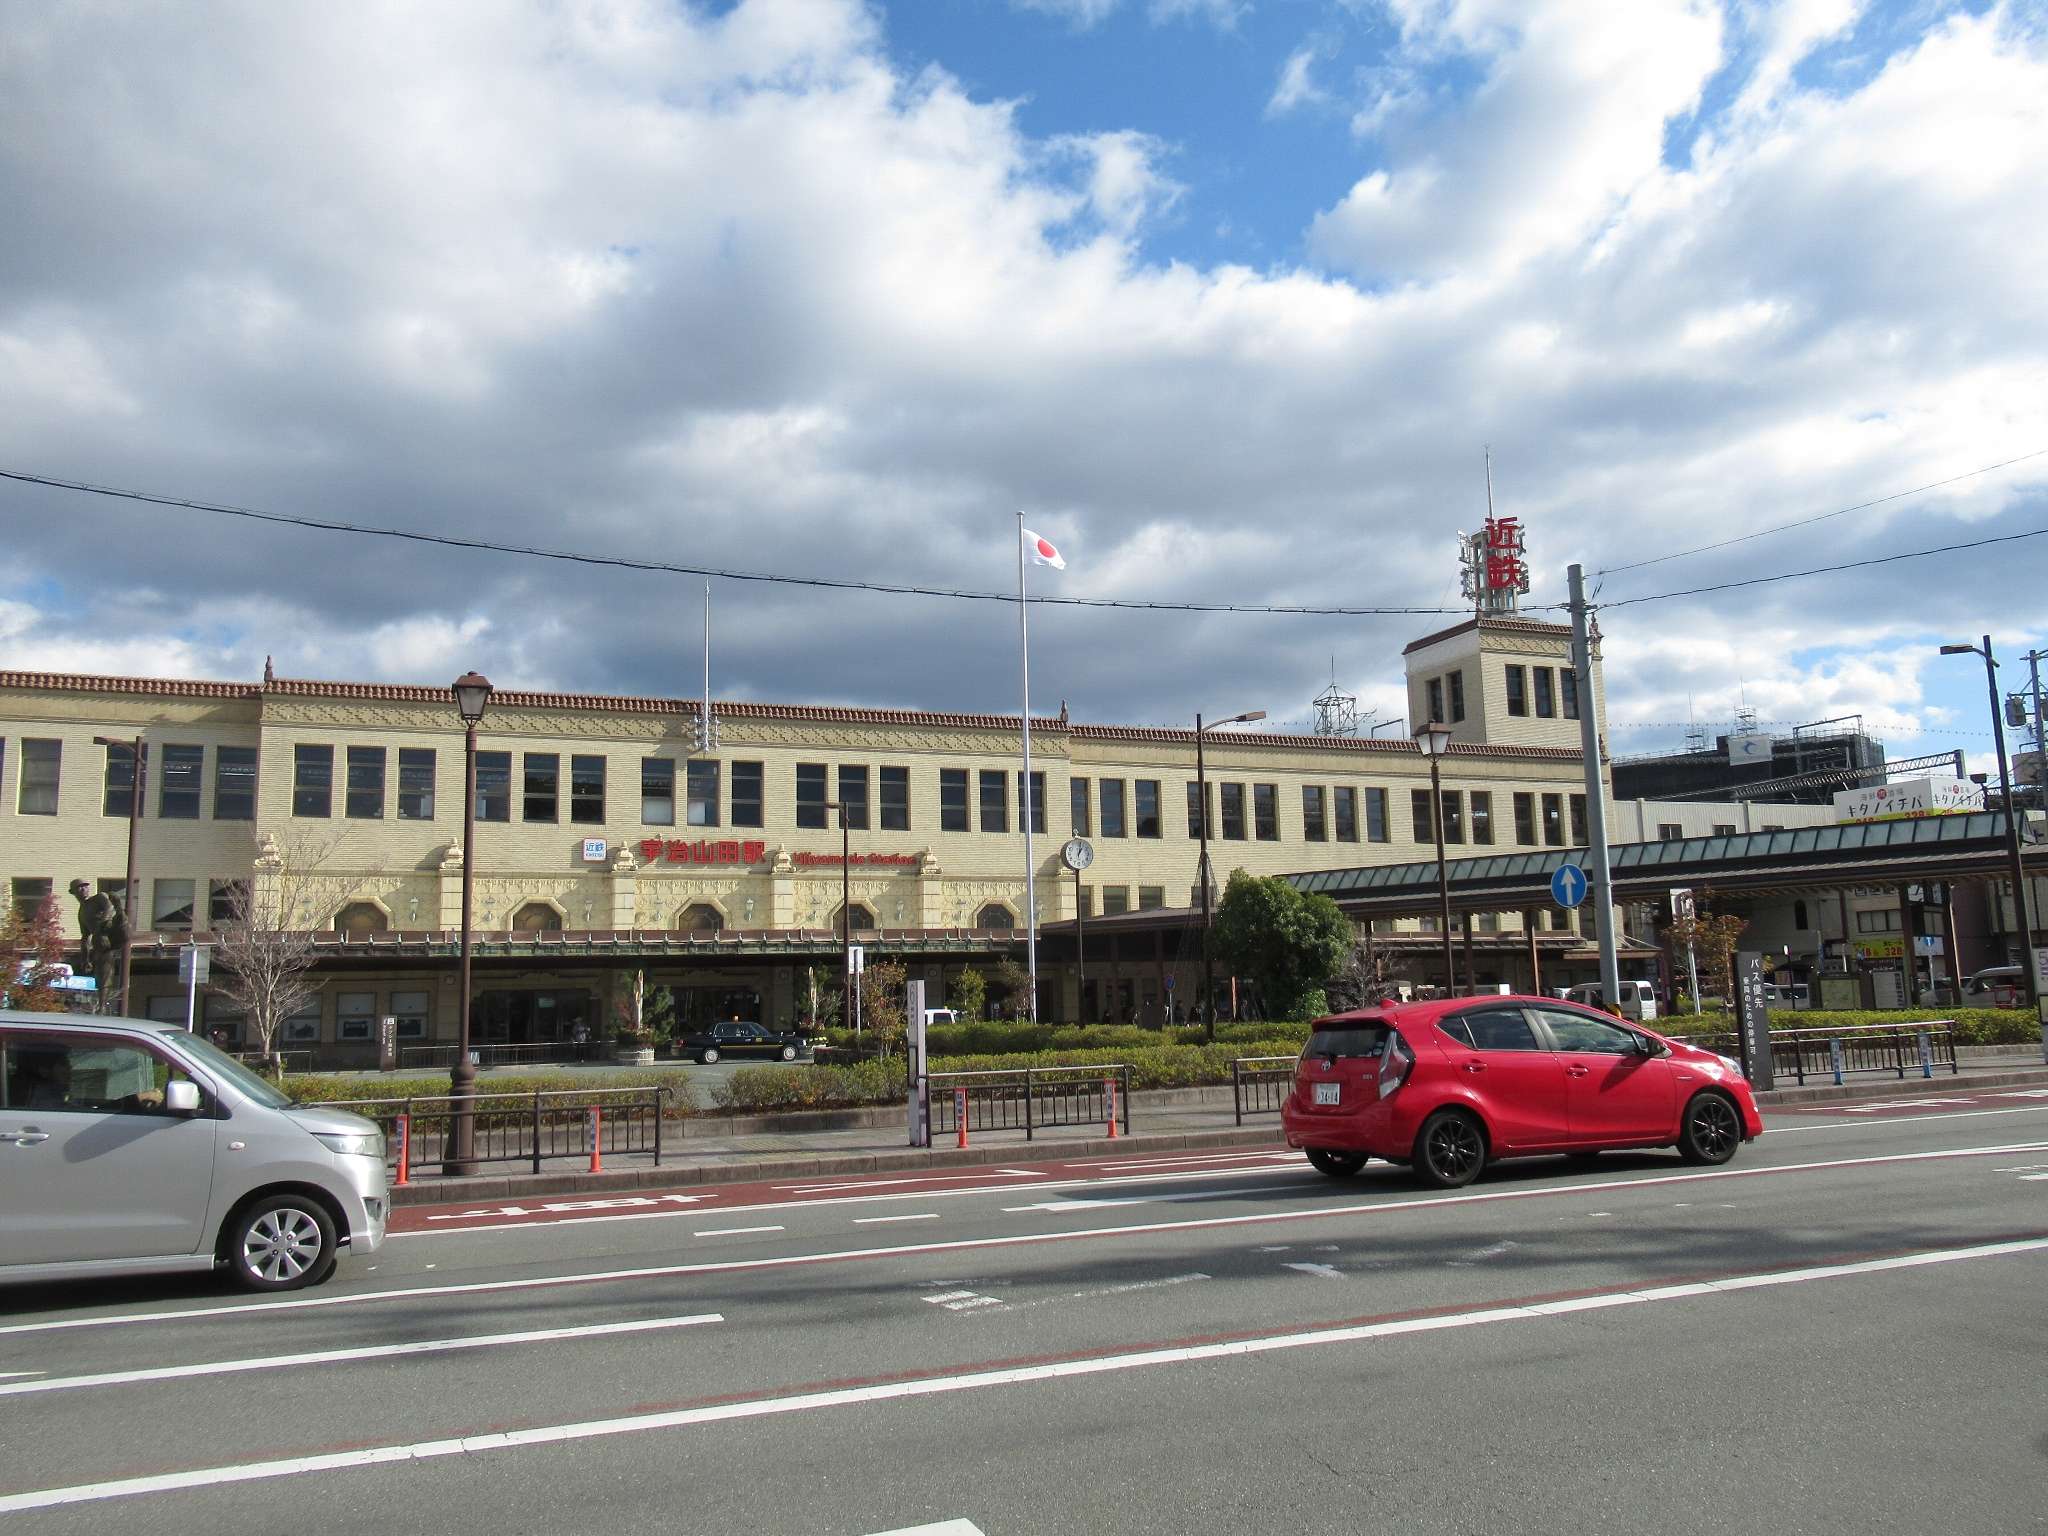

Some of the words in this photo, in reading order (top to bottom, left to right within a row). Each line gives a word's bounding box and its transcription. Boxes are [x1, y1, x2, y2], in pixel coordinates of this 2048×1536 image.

[1484, 516, 1521, 589] 近鉄
[1848, 794, 1922, 817] キタノイチバ
[640, 839, 766, 864] 宇治山田駅
[1750, 959, 1764, 1008] バス優先
